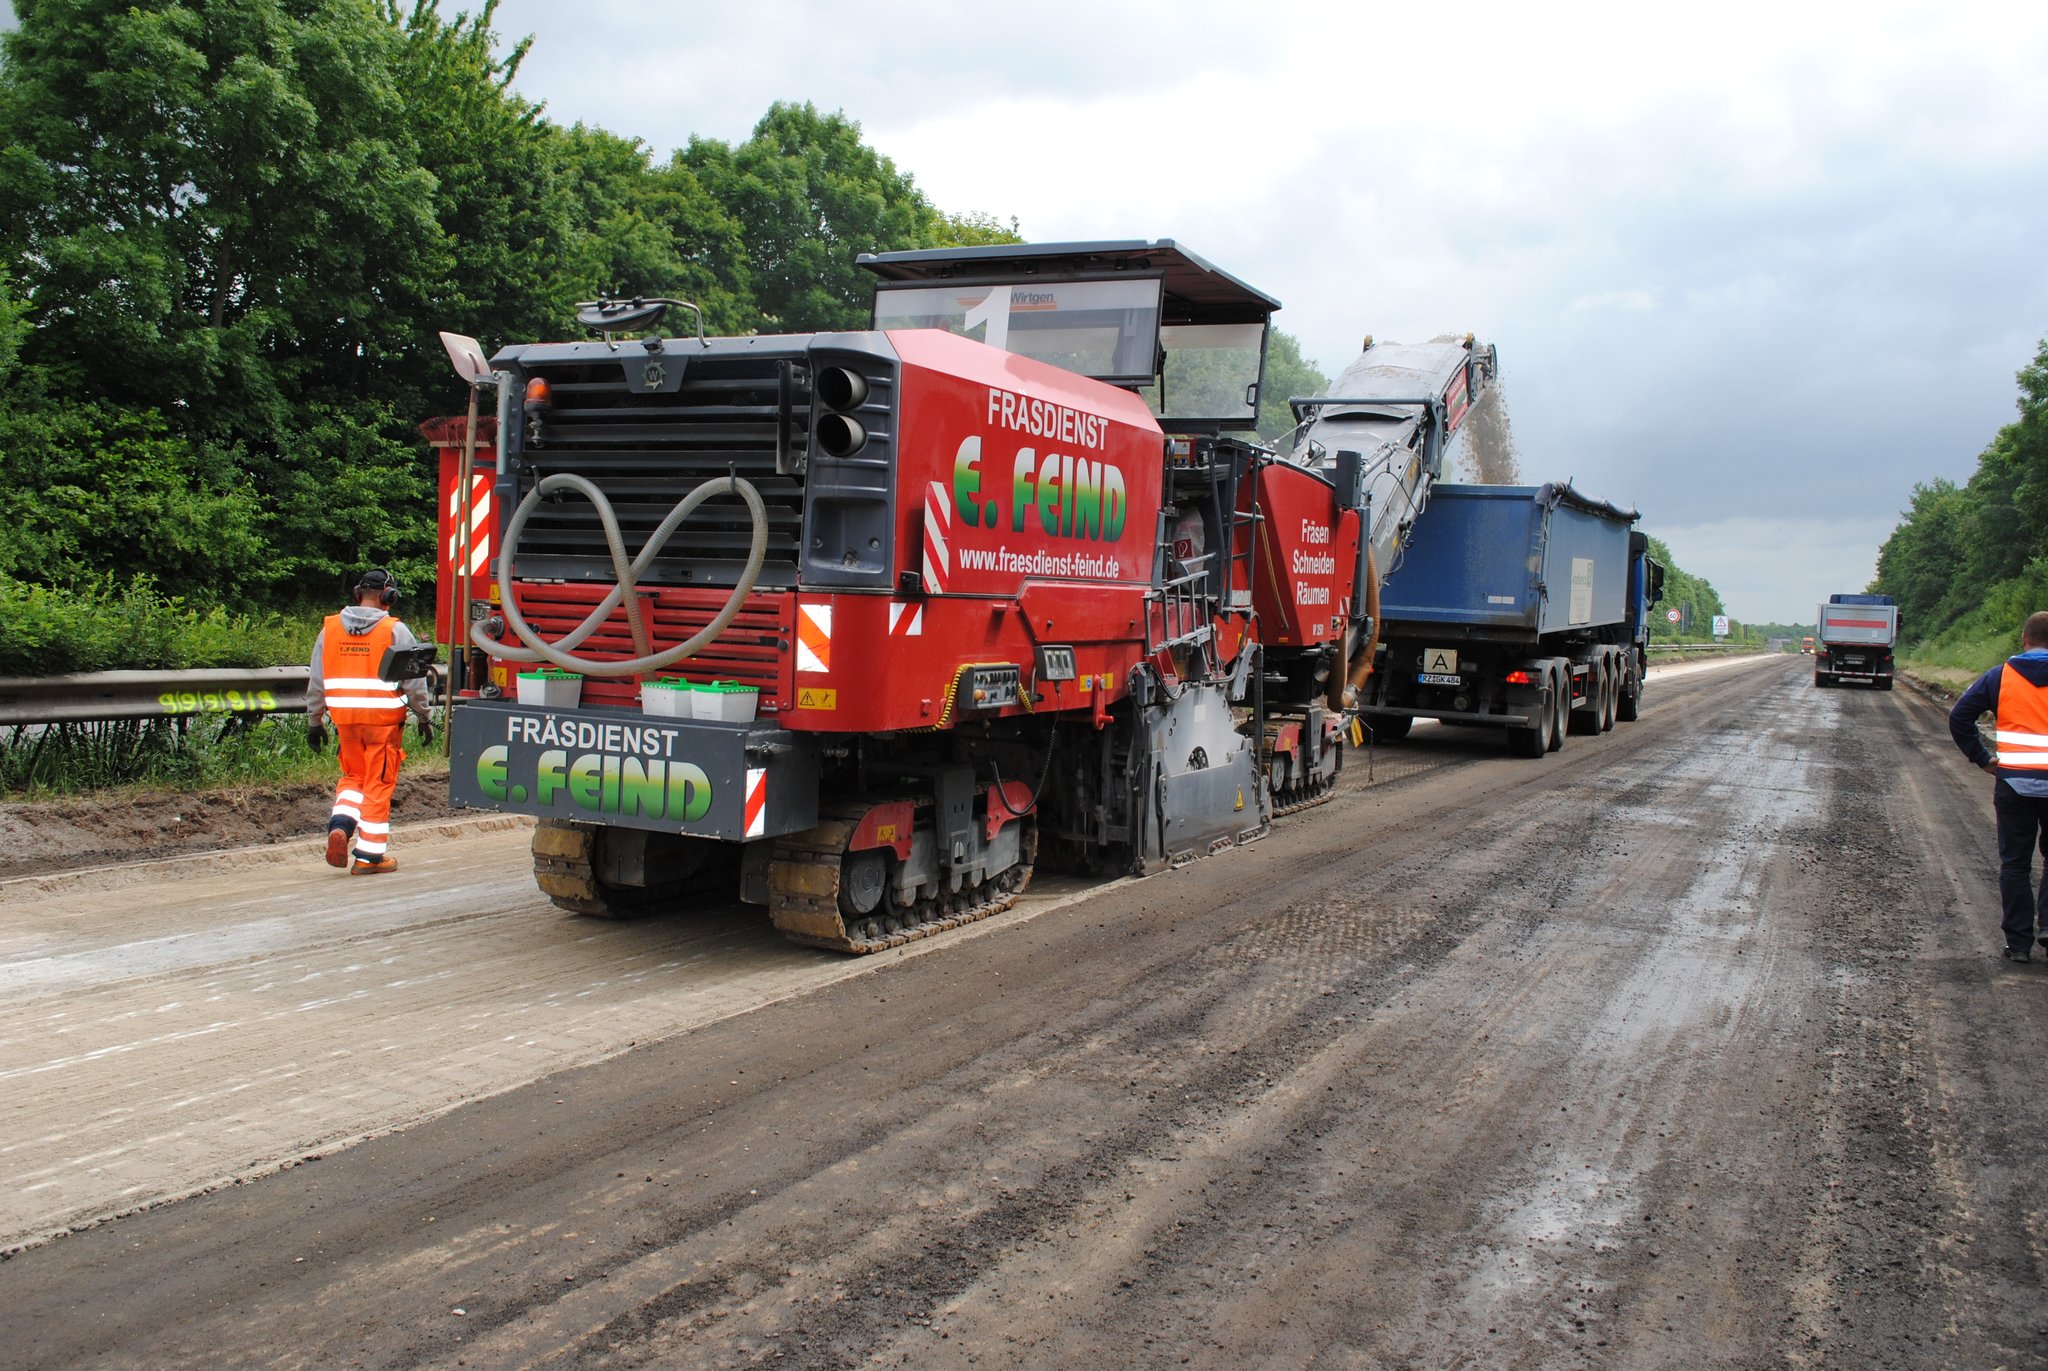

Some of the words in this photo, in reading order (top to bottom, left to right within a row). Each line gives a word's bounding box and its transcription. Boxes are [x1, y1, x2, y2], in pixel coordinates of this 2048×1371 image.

[1010, 292, 1054, 305] Wirtgen
[987, 387, 1109, 450] FRÄSDIENST
[953, 435, 998, 529] E.
[1012, 446, 1127, 543] FEIND
[1301, 518, 1329, 544] Fräsen
[959, 545, 1119, 578] www.fraesdienst-feind.de
[1292, 548, 1335, 575] Schneiden
[1296, 581, 1330, 605] Räumen
[1432, 653, 1448, 670] A
[507, 714, 679, 757] FRÄSDIENST
[476, 745, 528, 803] E.
[537, 750, 713, 822] FEIND
